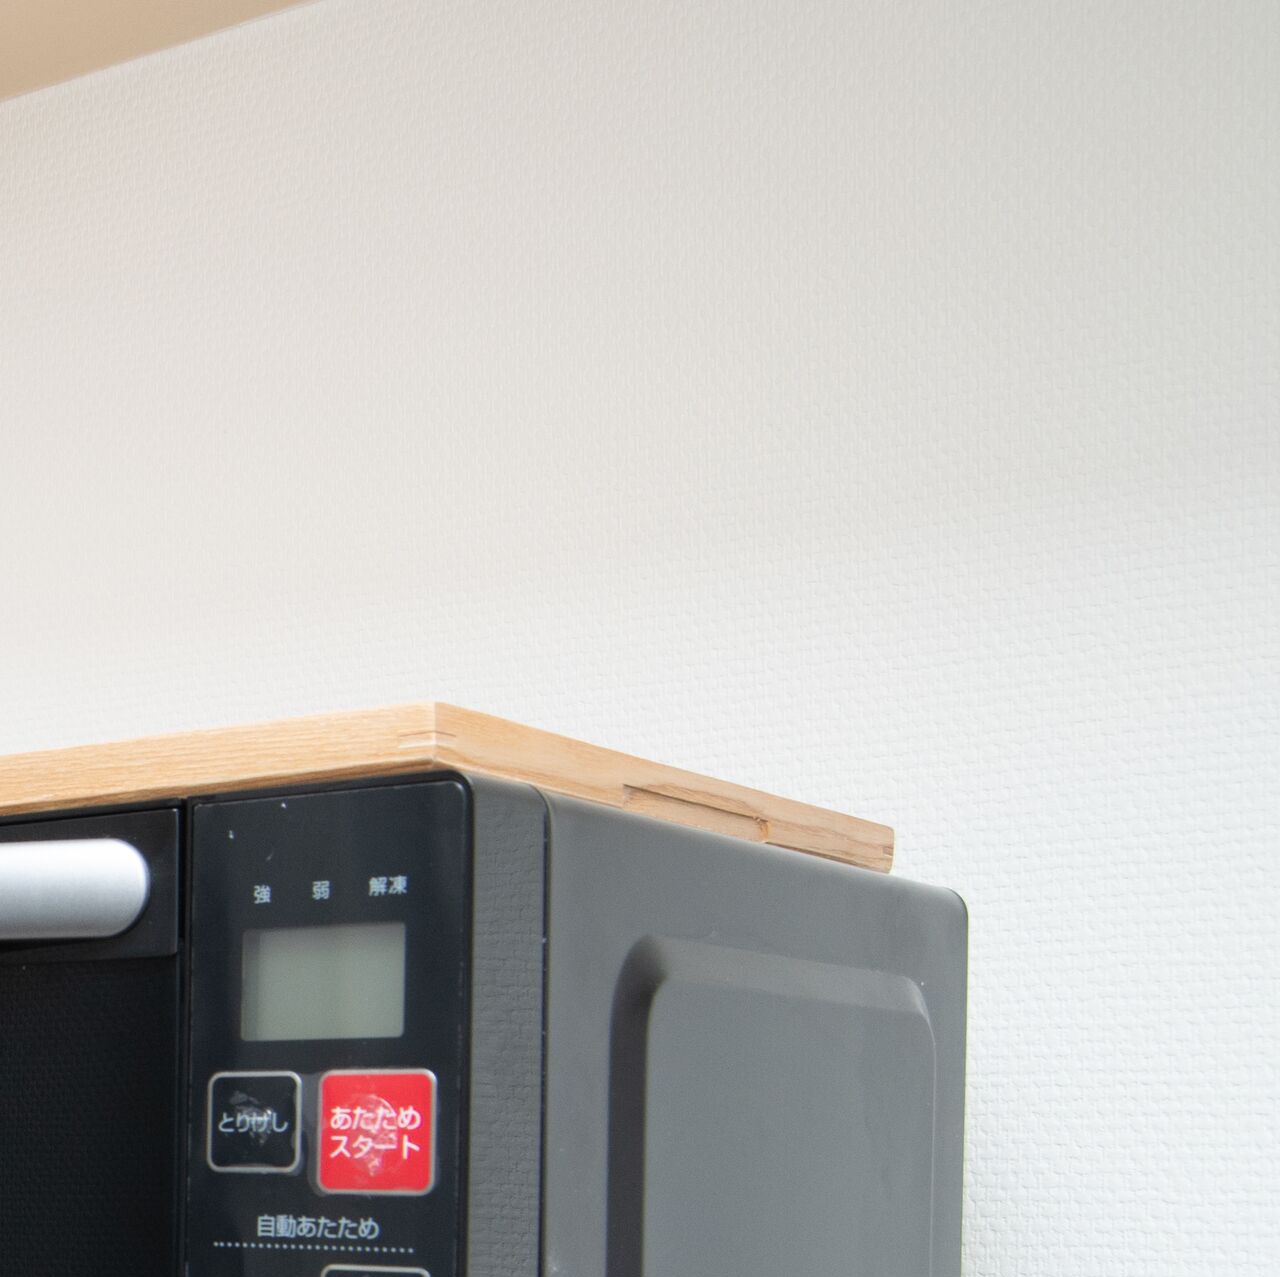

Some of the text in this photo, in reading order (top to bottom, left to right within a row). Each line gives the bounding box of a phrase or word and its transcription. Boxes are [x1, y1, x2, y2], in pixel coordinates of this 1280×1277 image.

[253, 876, 407, 904] 強 弱 解凍
[218, 1111, 288, 1133] とりけし
[330, 1106, 422, 1131] あたため
[330, 1134, 421, 1160] スタート
[256, 1215, 380, 1240] 自動あたため
